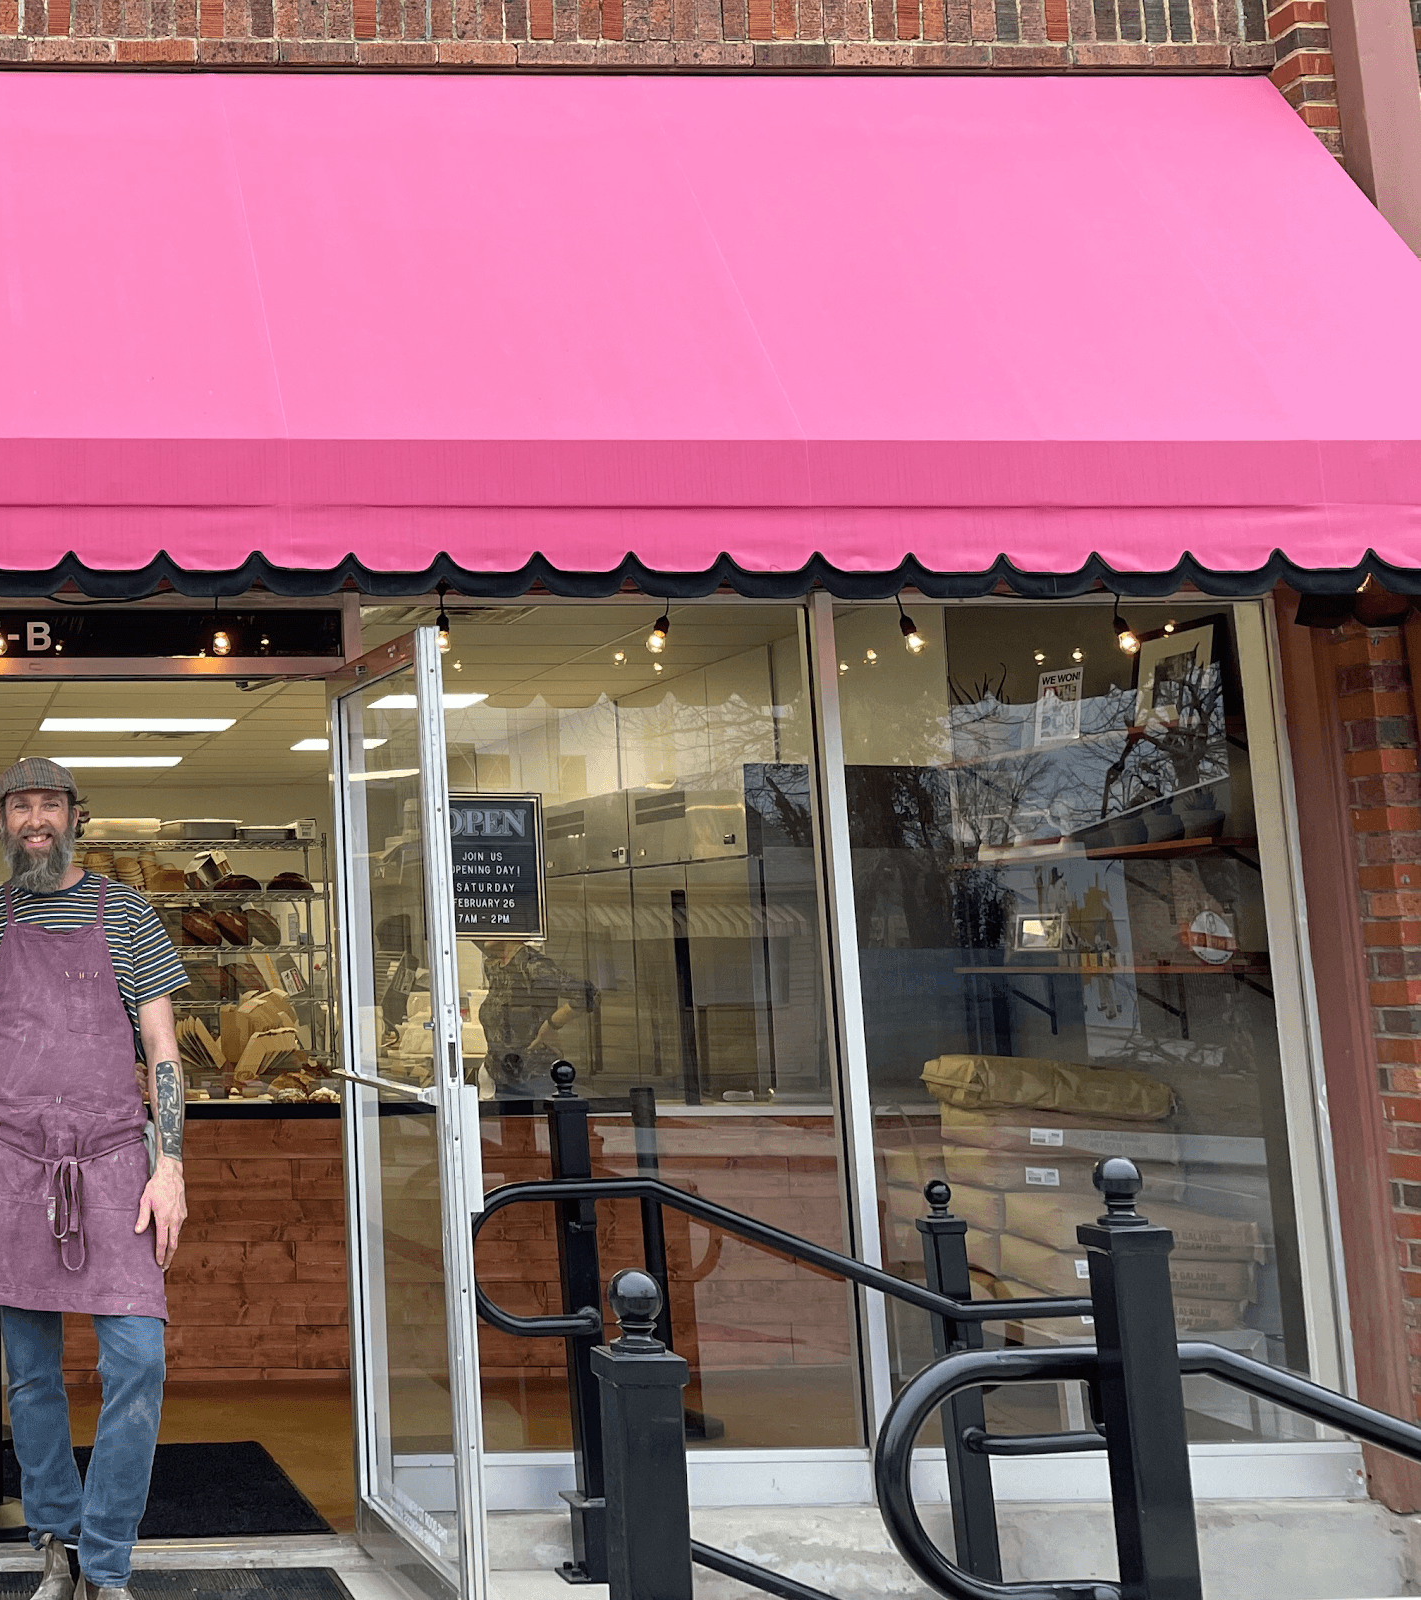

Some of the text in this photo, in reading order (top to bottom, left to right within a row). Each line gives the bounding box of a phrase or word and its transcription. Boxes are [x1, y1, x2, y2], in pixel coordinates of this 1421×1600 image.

[1042, 671, 1081, 686] WE WON!
[449, 808, 526, 837] OPEN
[462, 852, 503, 862] JOIN US
[496, 865, 520, 877] DAY!
[456, 882, 515, 893] SATURDAY
[503, 898, 515, 908] 26
[458, 913, 478, 924] 7AM
[490, 913, 510, 924] 2PM
